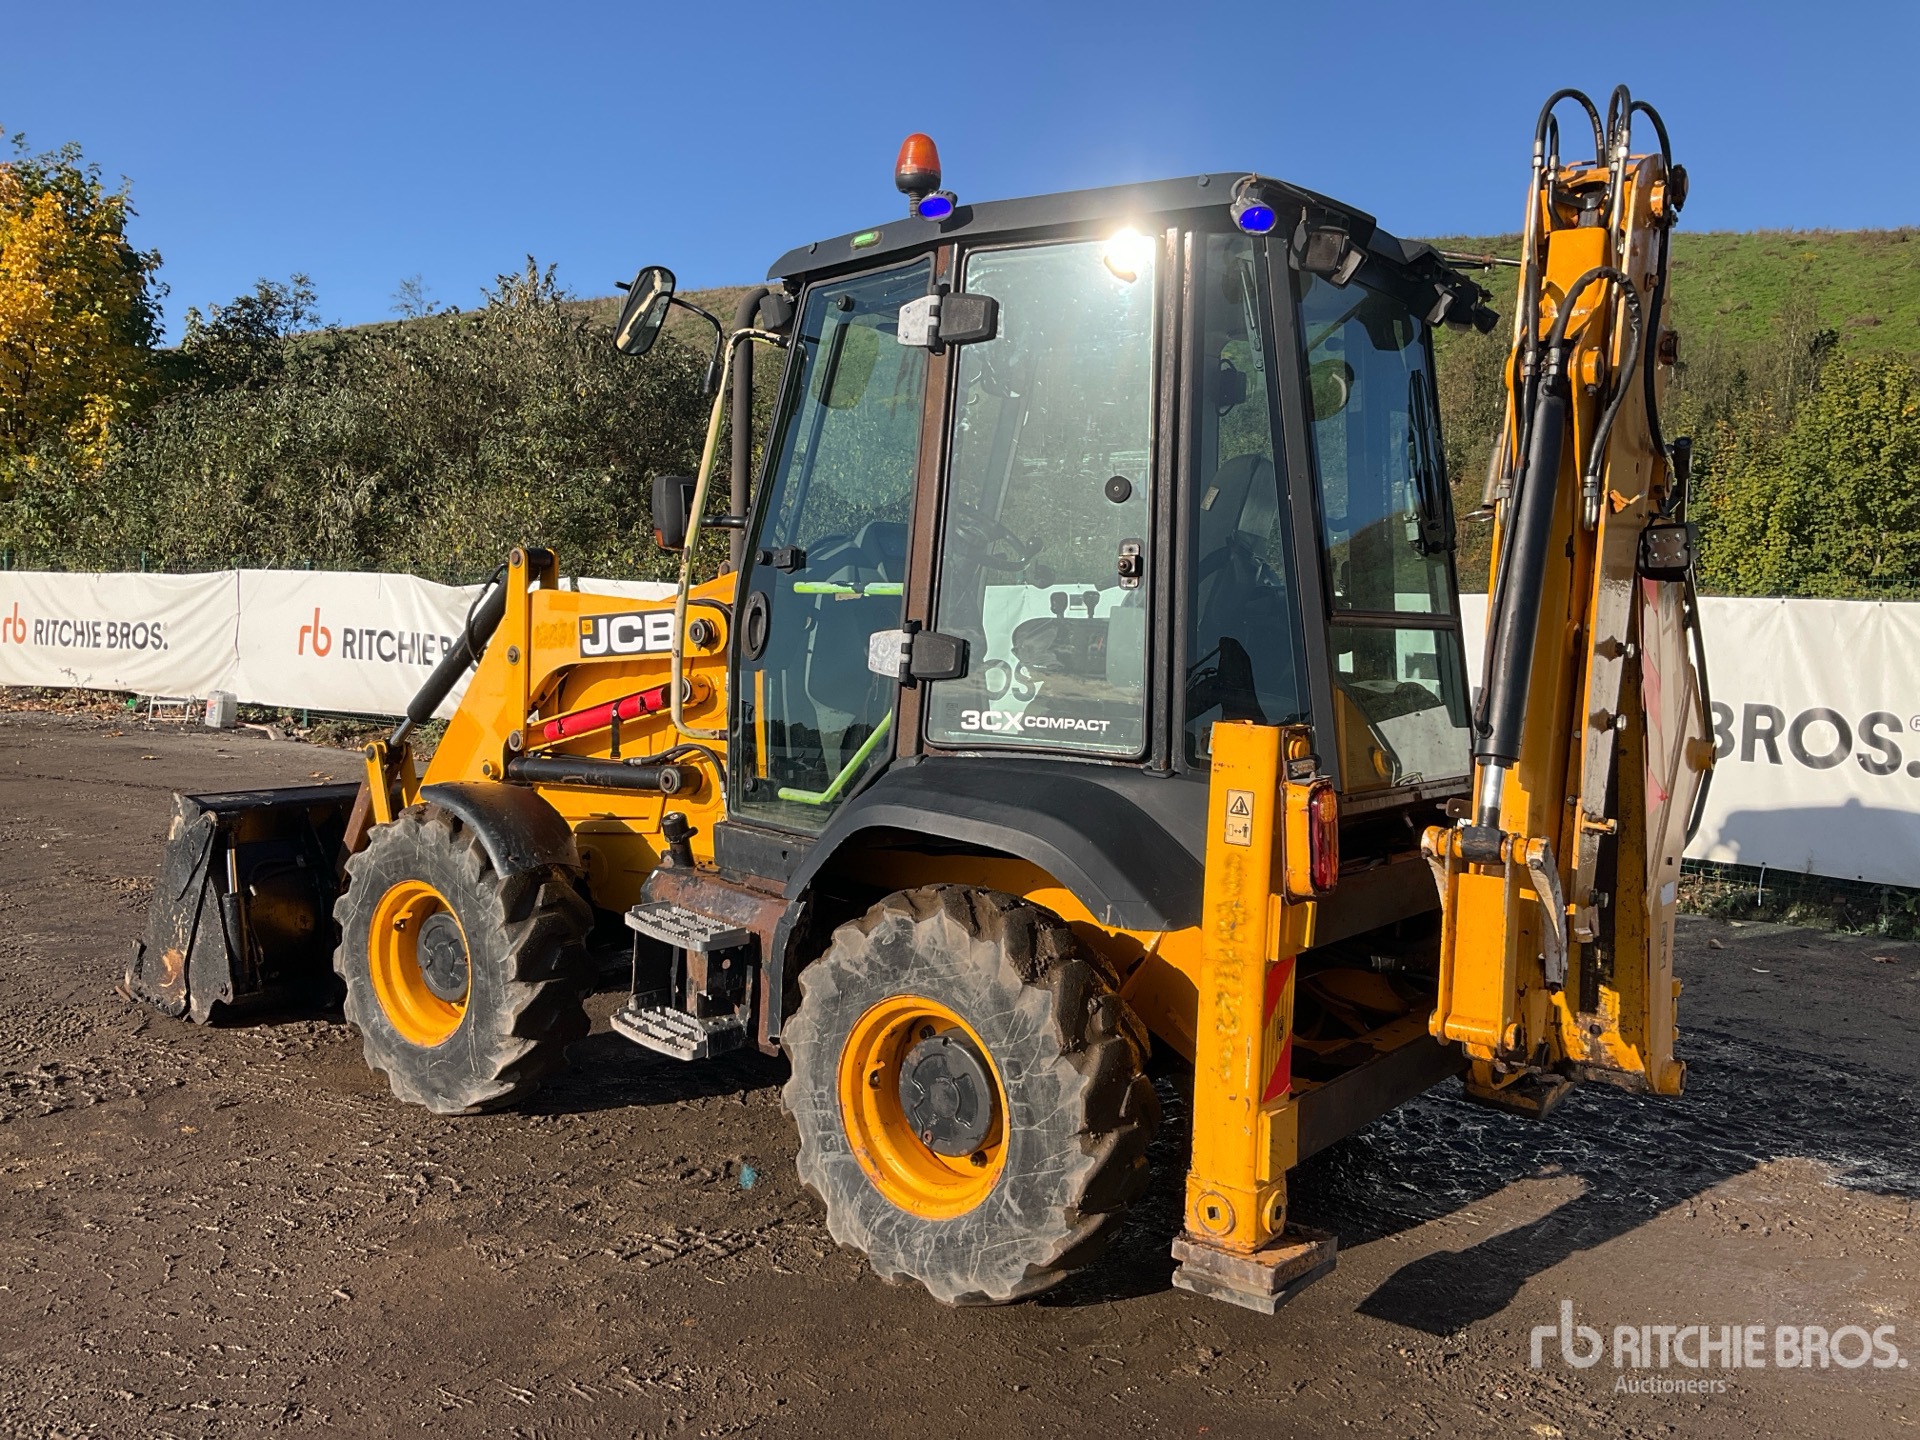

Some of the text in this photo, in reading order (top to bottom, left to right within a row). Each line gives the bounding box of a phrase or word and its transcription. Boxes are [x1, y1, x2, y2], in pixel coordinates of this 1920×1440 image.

[2, 601, 168, 650] rb RITCHIE BROS.
[298, 607, 332, 657] rb
[342, 627, 436, 666] RITCHIE
[582, 612, 676, 655] JCB
[960, 710, 1111, 732] 3CX COMPACT
